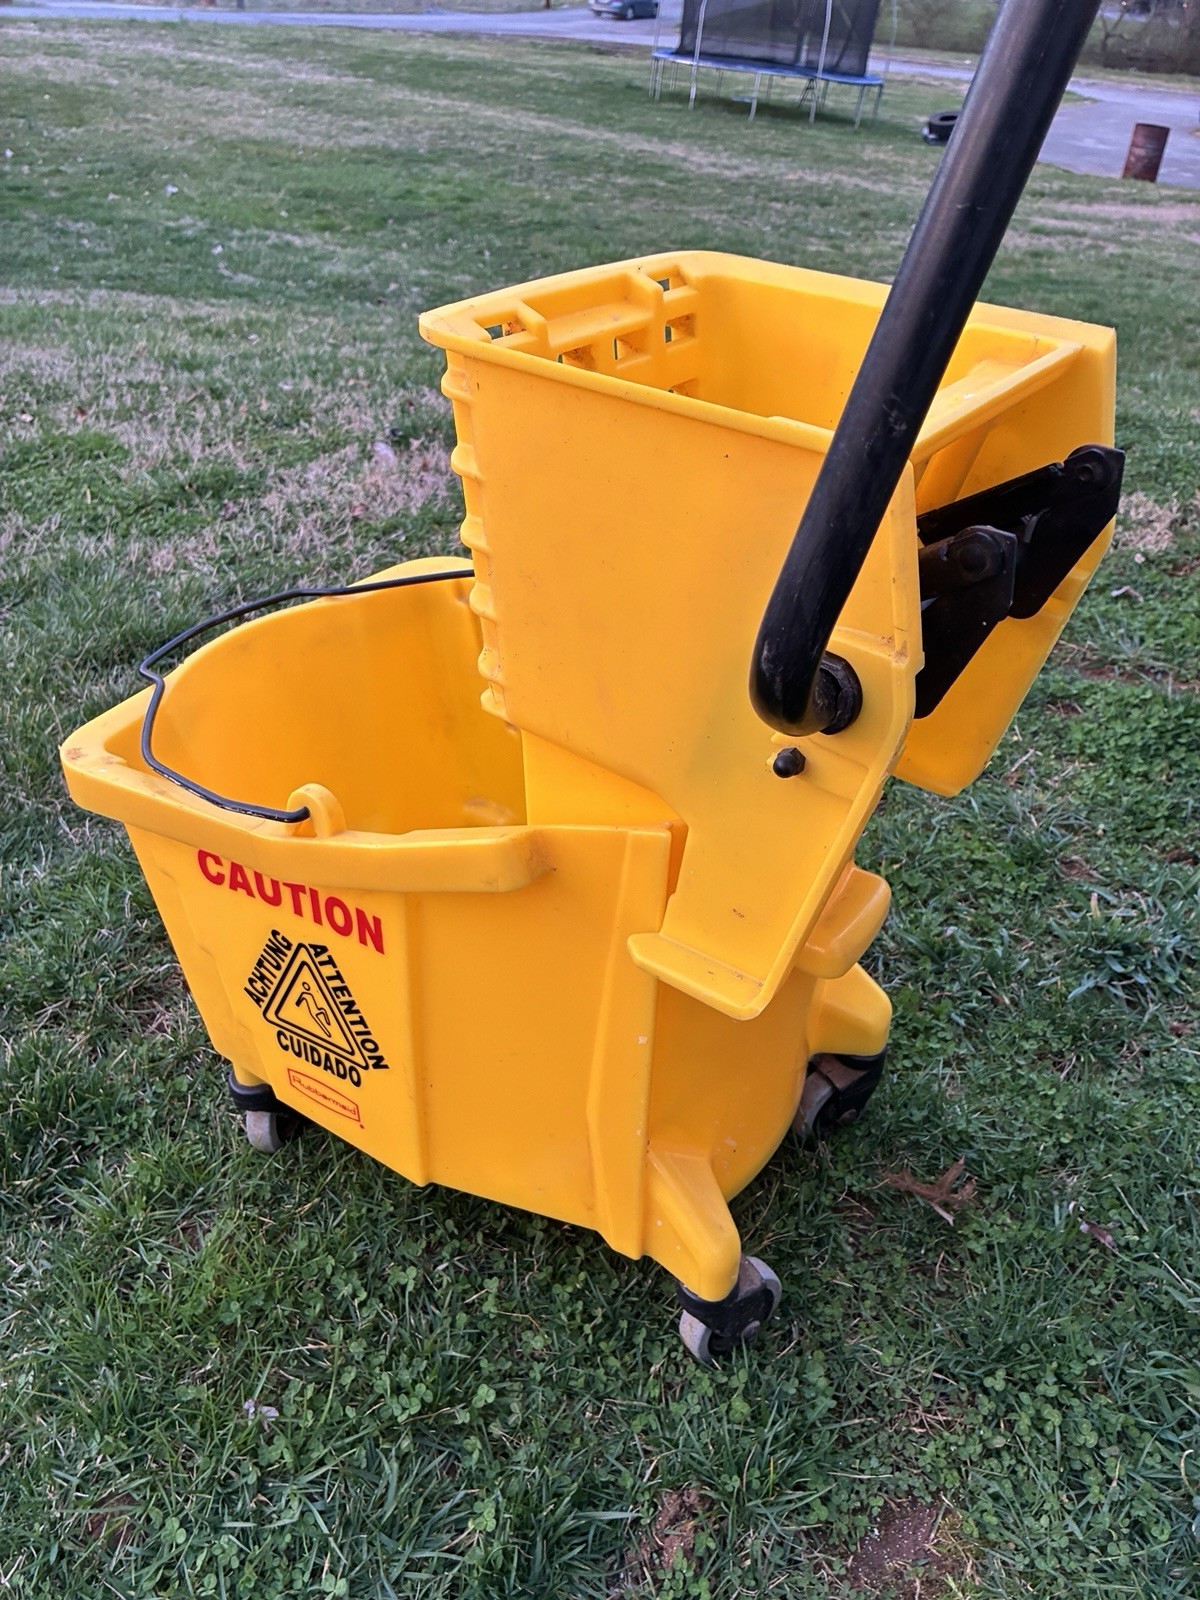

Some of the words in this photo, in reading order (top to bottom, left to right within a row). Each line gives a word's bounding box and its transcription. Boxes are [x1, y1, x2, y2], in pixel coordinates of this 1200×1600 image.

[197, 849, 385, 955] CAUTION
[243, 929, 292, 1008] ACHTUNG
[308, 942, 389, 1070] ATTENTION
[276, 1029, 361, 1087] CUIDADO
[292, 1074, 357, 1116] Rubbermaid
